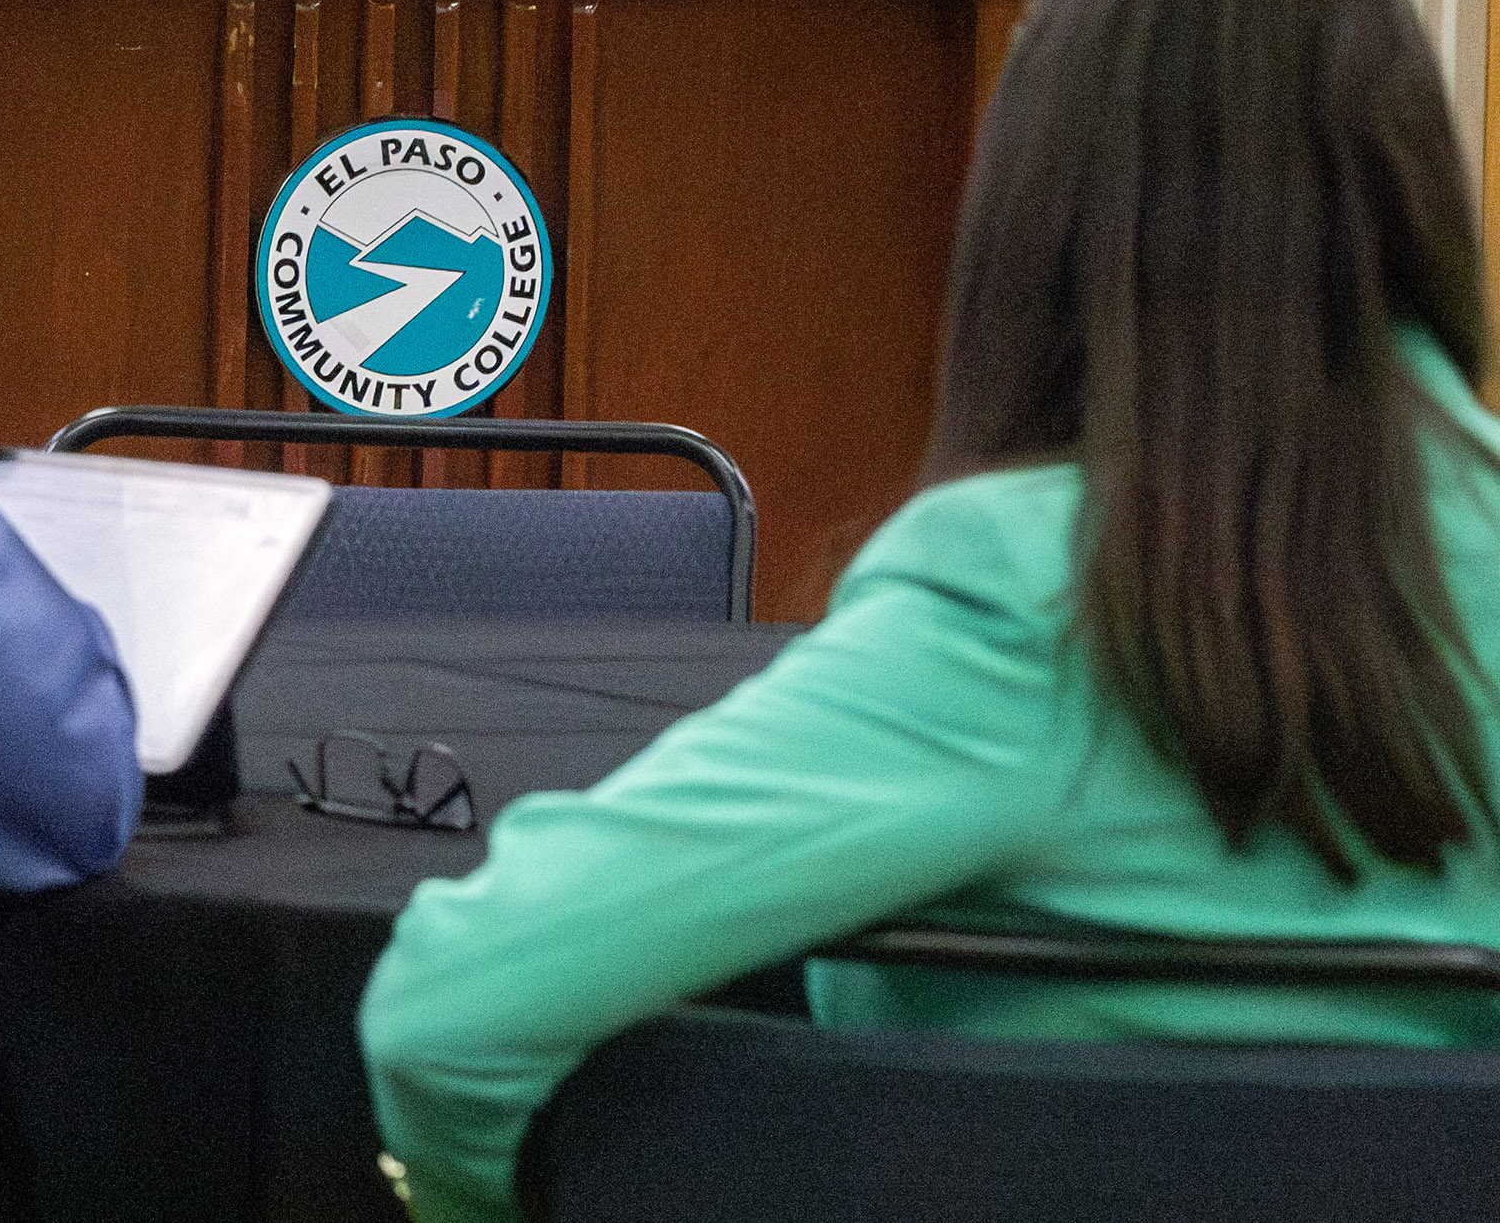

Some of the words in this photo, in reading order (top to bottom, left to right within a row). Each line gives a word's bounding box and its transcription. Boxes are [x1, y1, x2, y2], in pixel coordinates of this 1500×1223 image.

[315, 154, 367, 196] EL
[381, 138, 486, 185] PASO
[274, 232, 437, 410] COMMUNITY
[453, 215, 536, 391] COLLEGE
